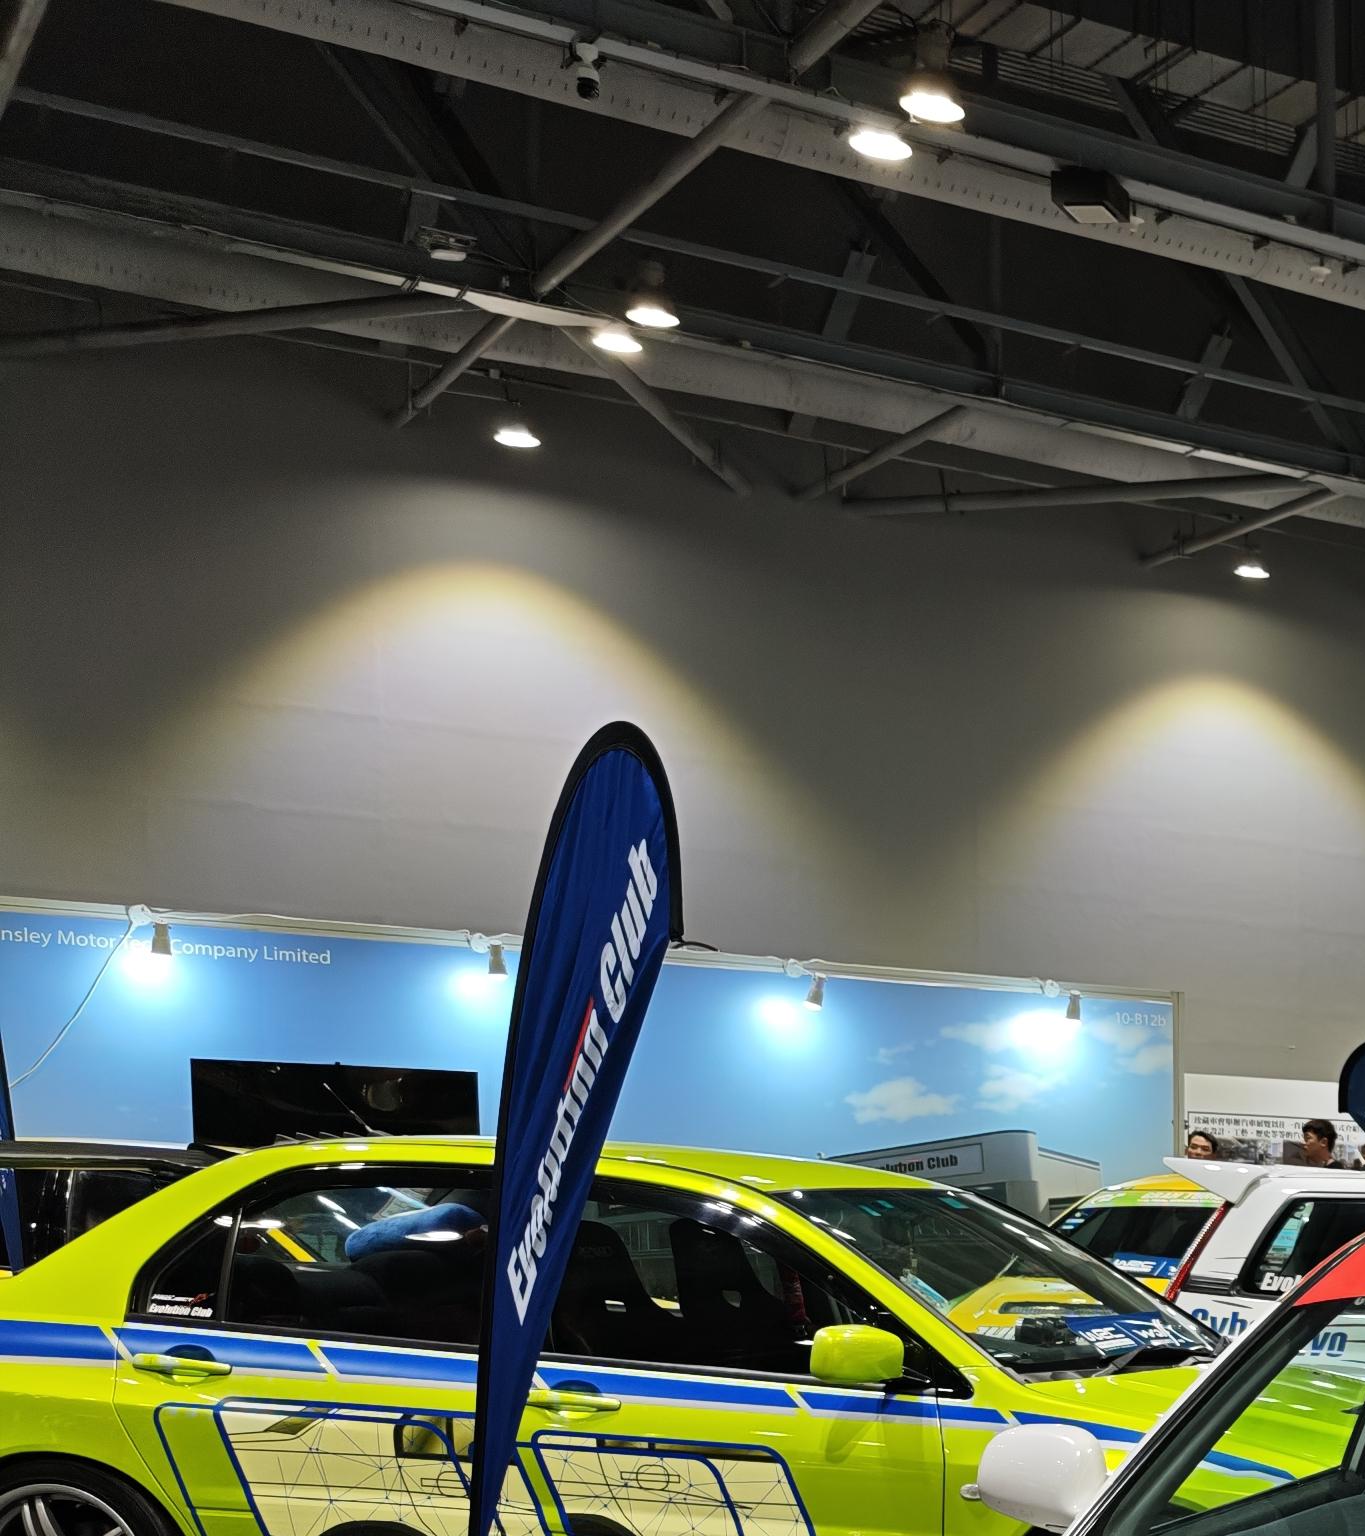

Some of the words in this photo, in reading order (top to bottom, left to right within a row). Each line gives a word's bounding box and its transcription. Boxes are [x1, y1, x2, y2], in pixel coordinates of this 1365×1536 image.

[58, 931, 115, 951] Motor
[171, 937, 258, 964] Company
[263, 944, 332, 965] Limited
[507, 1000, 609, 1327] Evolution
[599, 838, 659, 1025] Club
[926, 1154, 959, 1170] Club
